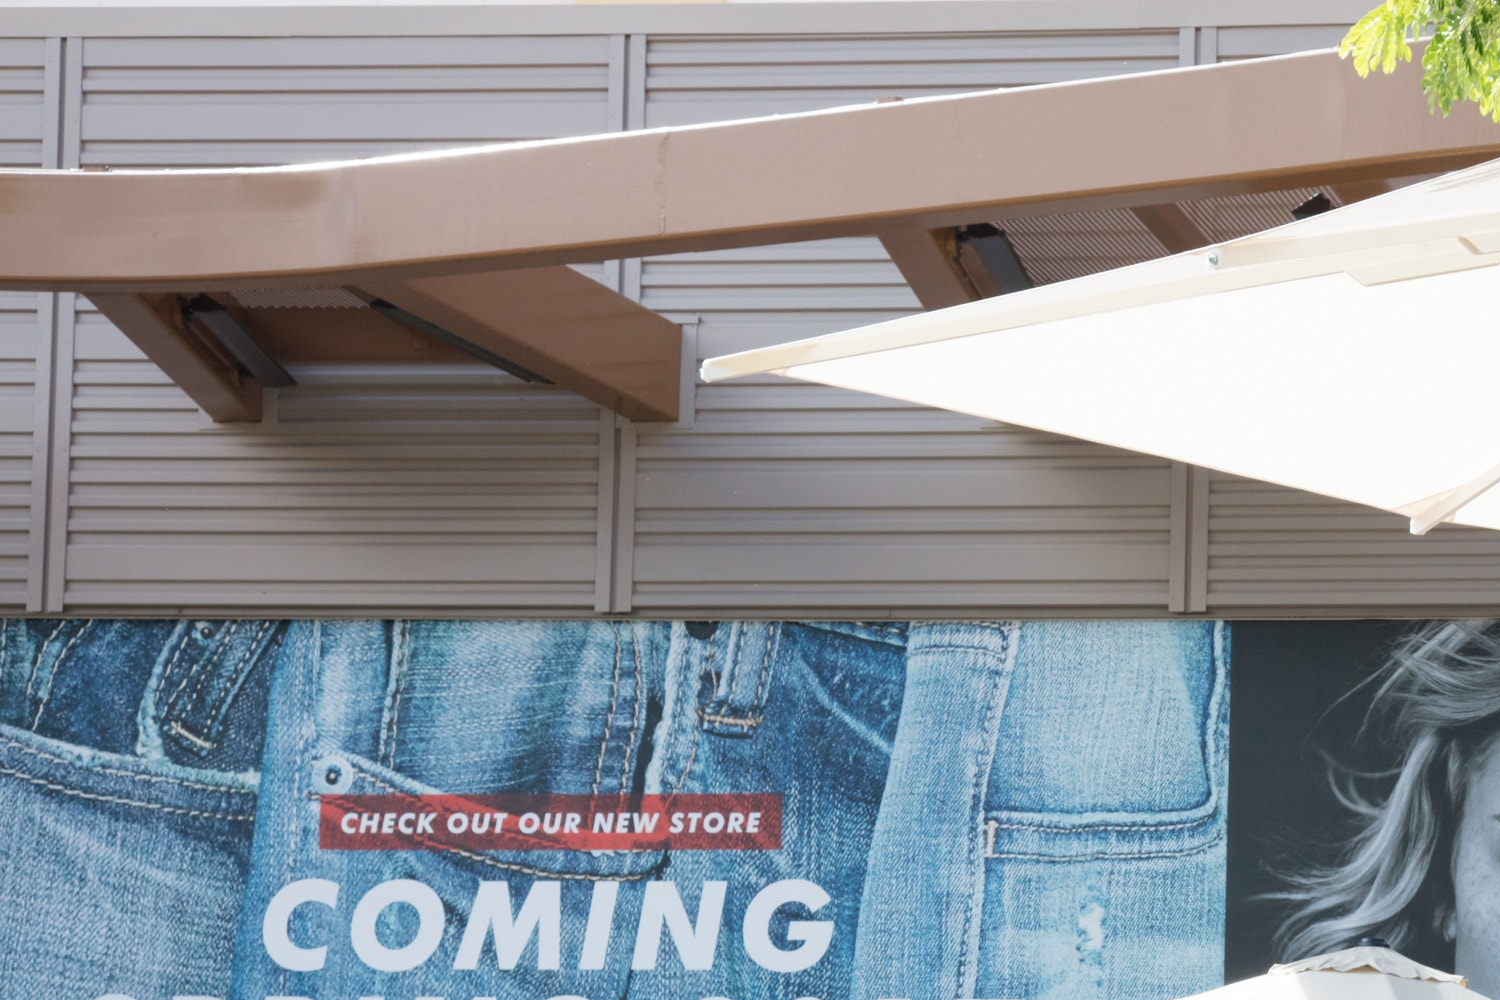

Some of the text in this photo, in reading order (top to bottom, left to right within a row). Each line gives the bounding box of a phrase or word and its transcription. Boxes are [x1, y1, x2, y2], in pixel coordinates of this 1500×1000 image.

[340, 811, 762, 835] CHECK OUT OUR NEW STORE
[262, 878, 835, 973] COMING
